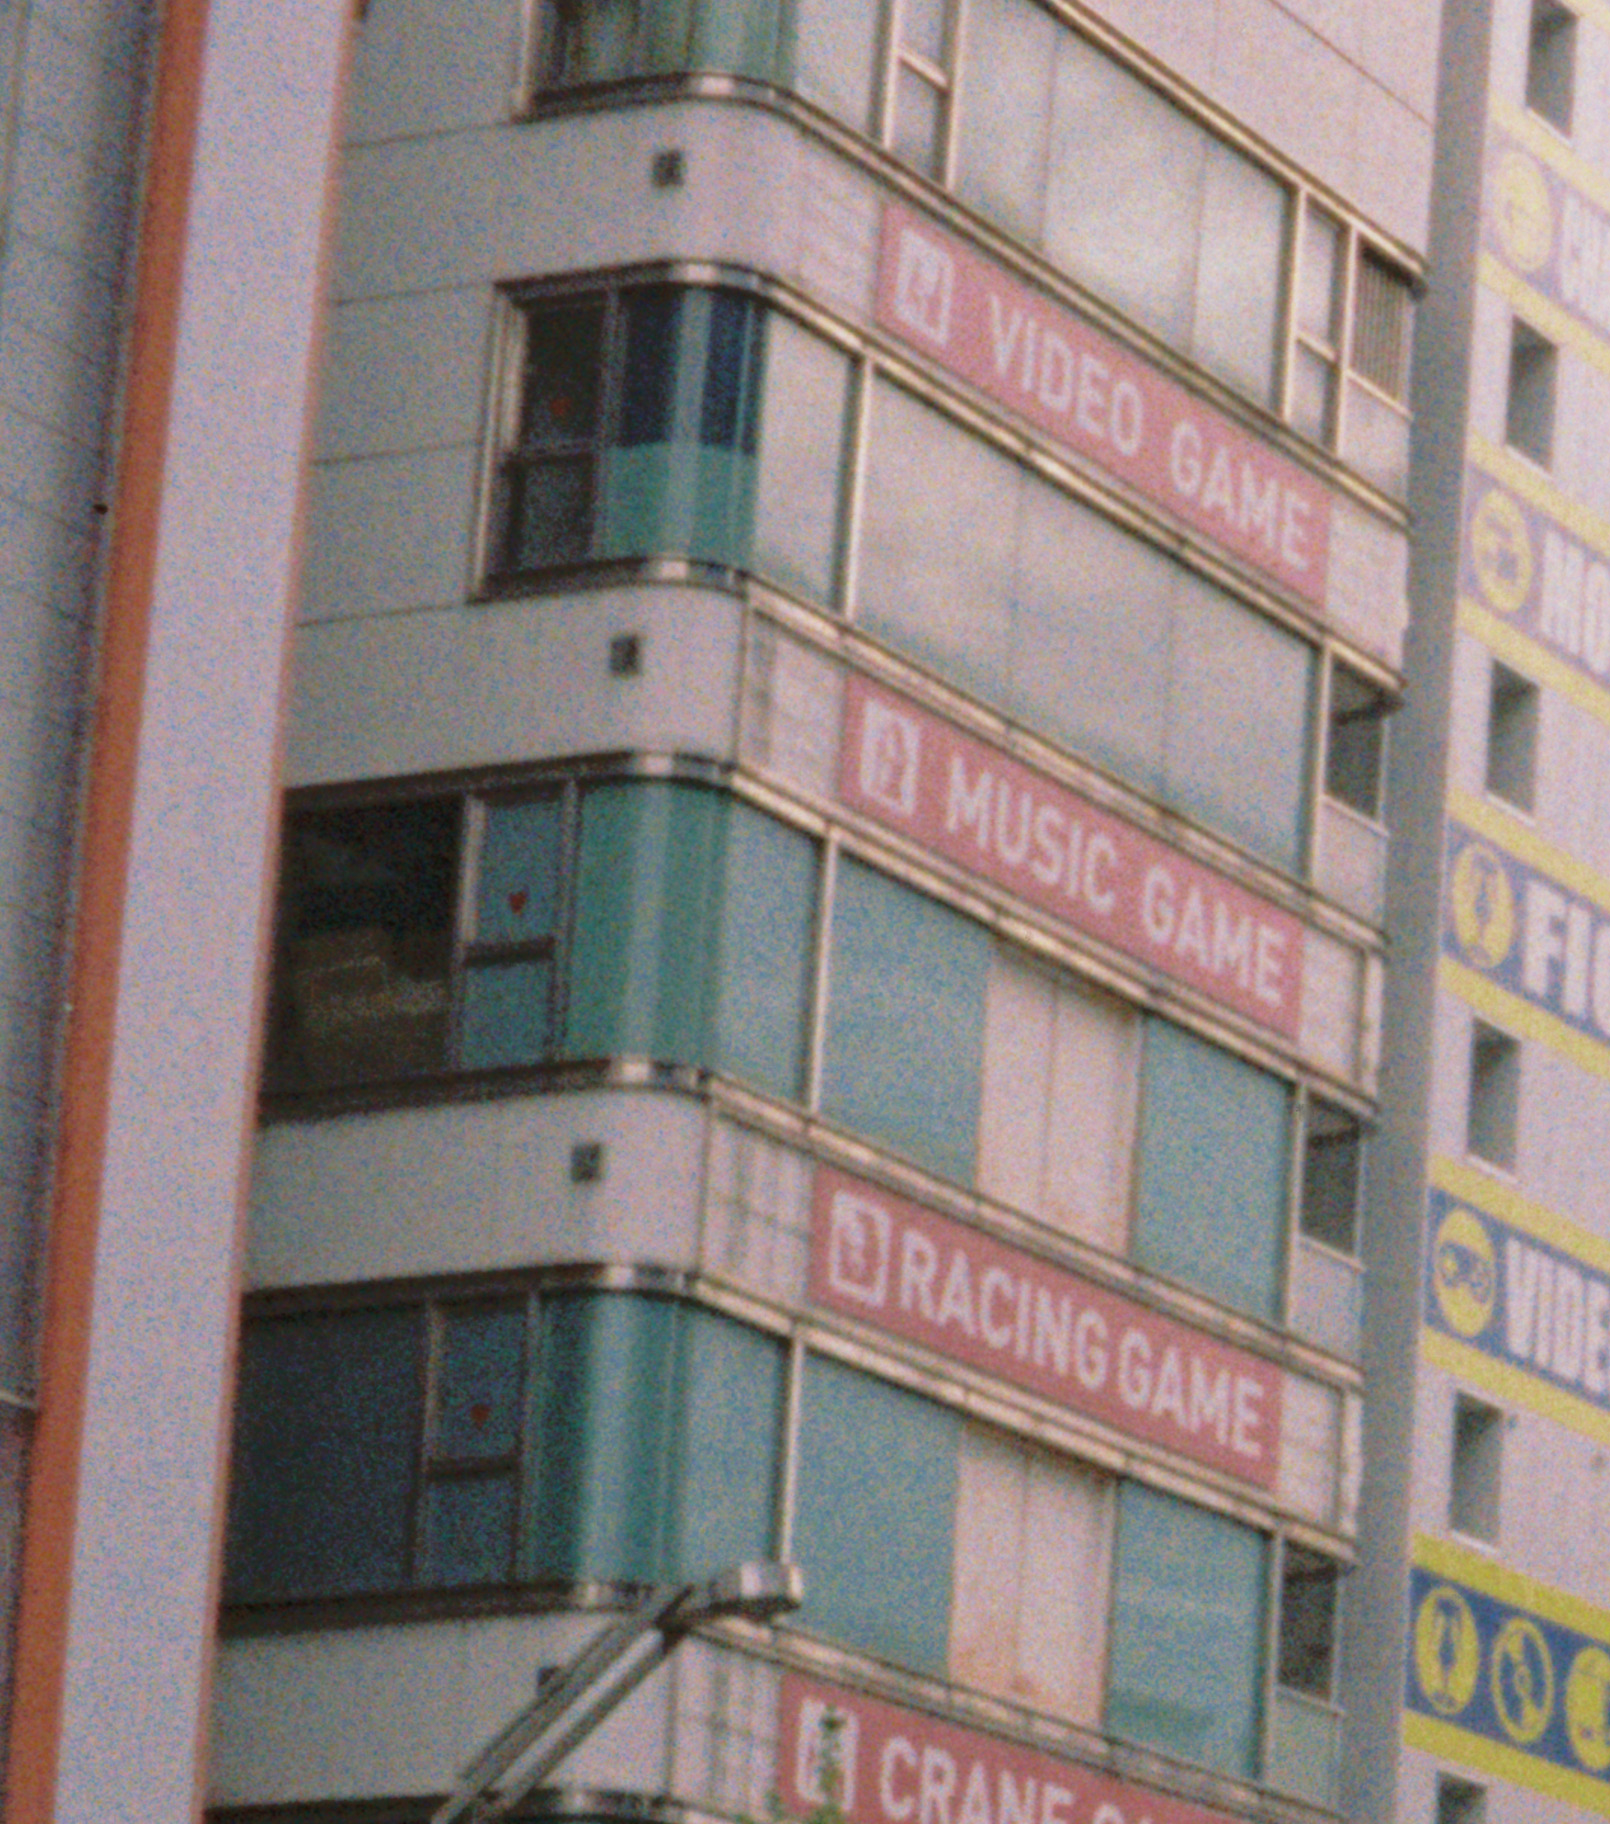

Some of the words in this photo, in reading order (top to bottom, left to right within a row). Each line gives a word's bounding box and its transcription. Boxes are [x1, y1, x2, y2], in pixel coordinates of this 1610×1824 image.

[990, 292, 1145, 457] VIDEO
[1171, 418, 1312, 571] GAME
[946, 751, 1117, 915] MUSIC
[1141, 866, 1282, 1008] GAME
[900, 1230, 1108, 1392] RACING
[1119, 1332, 1263, 1459] GAME
